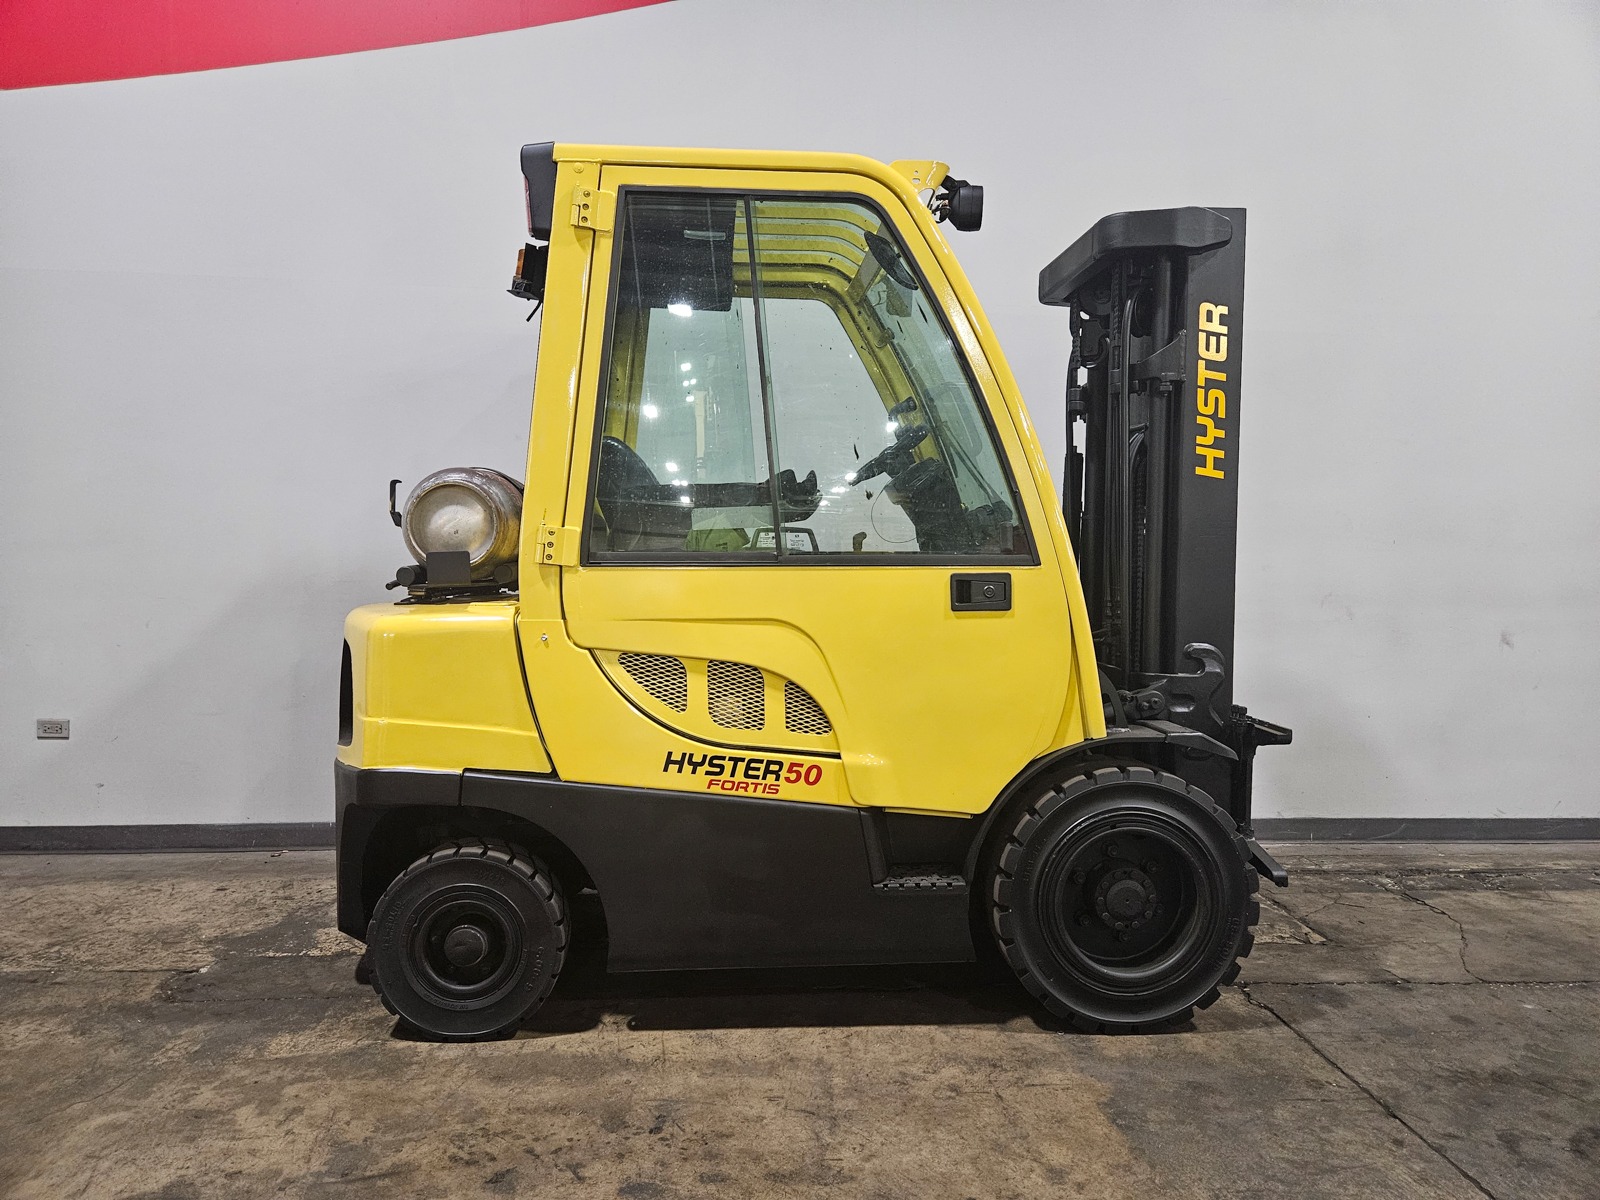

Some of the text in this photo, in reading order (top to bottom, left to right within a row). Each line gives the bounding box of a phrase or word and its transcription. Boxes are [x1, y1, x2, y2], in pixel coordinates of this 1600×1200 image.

[1195, 301, 1229, 479] HYSTER
[662, 751, 823, 786] HYSTER 50
[706, 779, 781, 795] FORTIS
